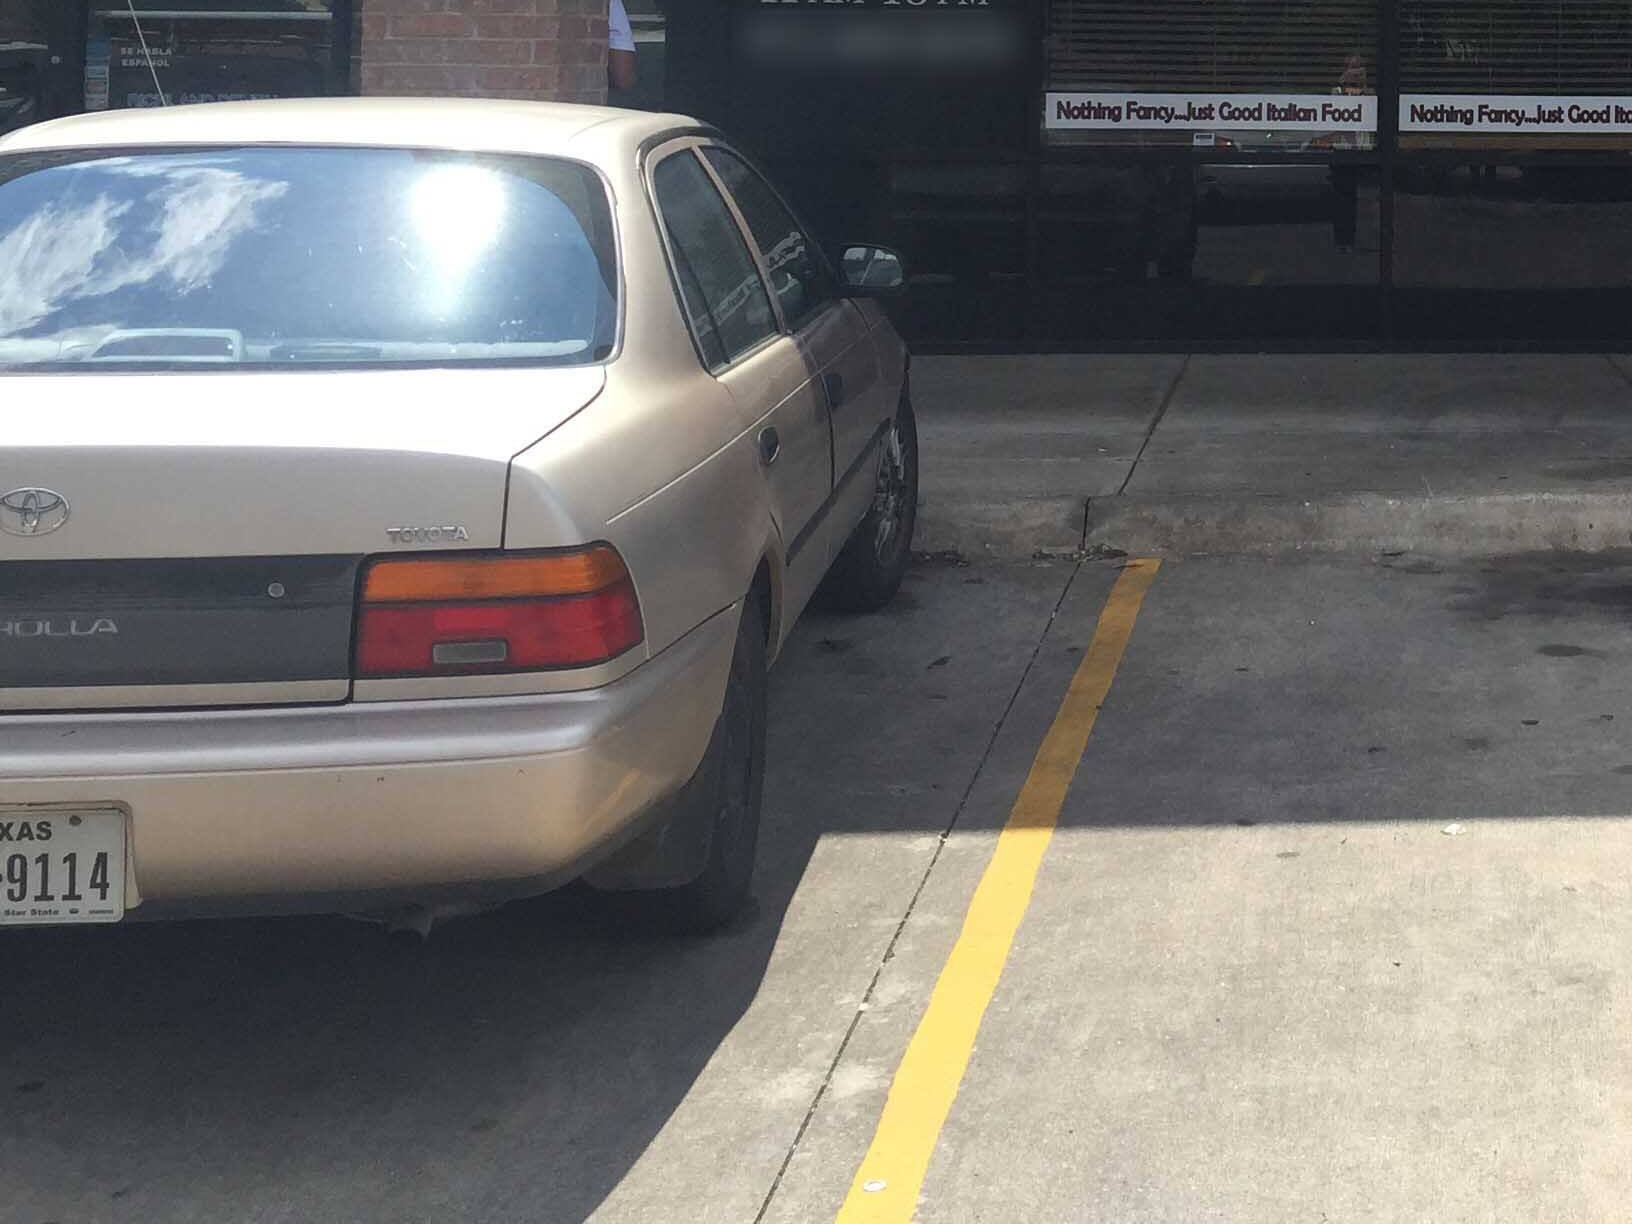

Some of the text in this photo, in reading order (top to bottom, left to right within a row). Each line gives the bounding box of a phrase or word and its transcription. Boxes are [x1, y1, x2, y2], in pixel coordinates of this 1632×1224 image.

[1056, 101, 1122, 123] Nothing
[1218, 103, 1263, 122] Good
[1267, 102, 1318, 122] Italian
[1321, 103, 1362, 122] Food
[1410, 104, 1474, 126] Nothing
[1567, 105, 1611, 124] Good
[386, 525, 469, 544] TOYOTA
